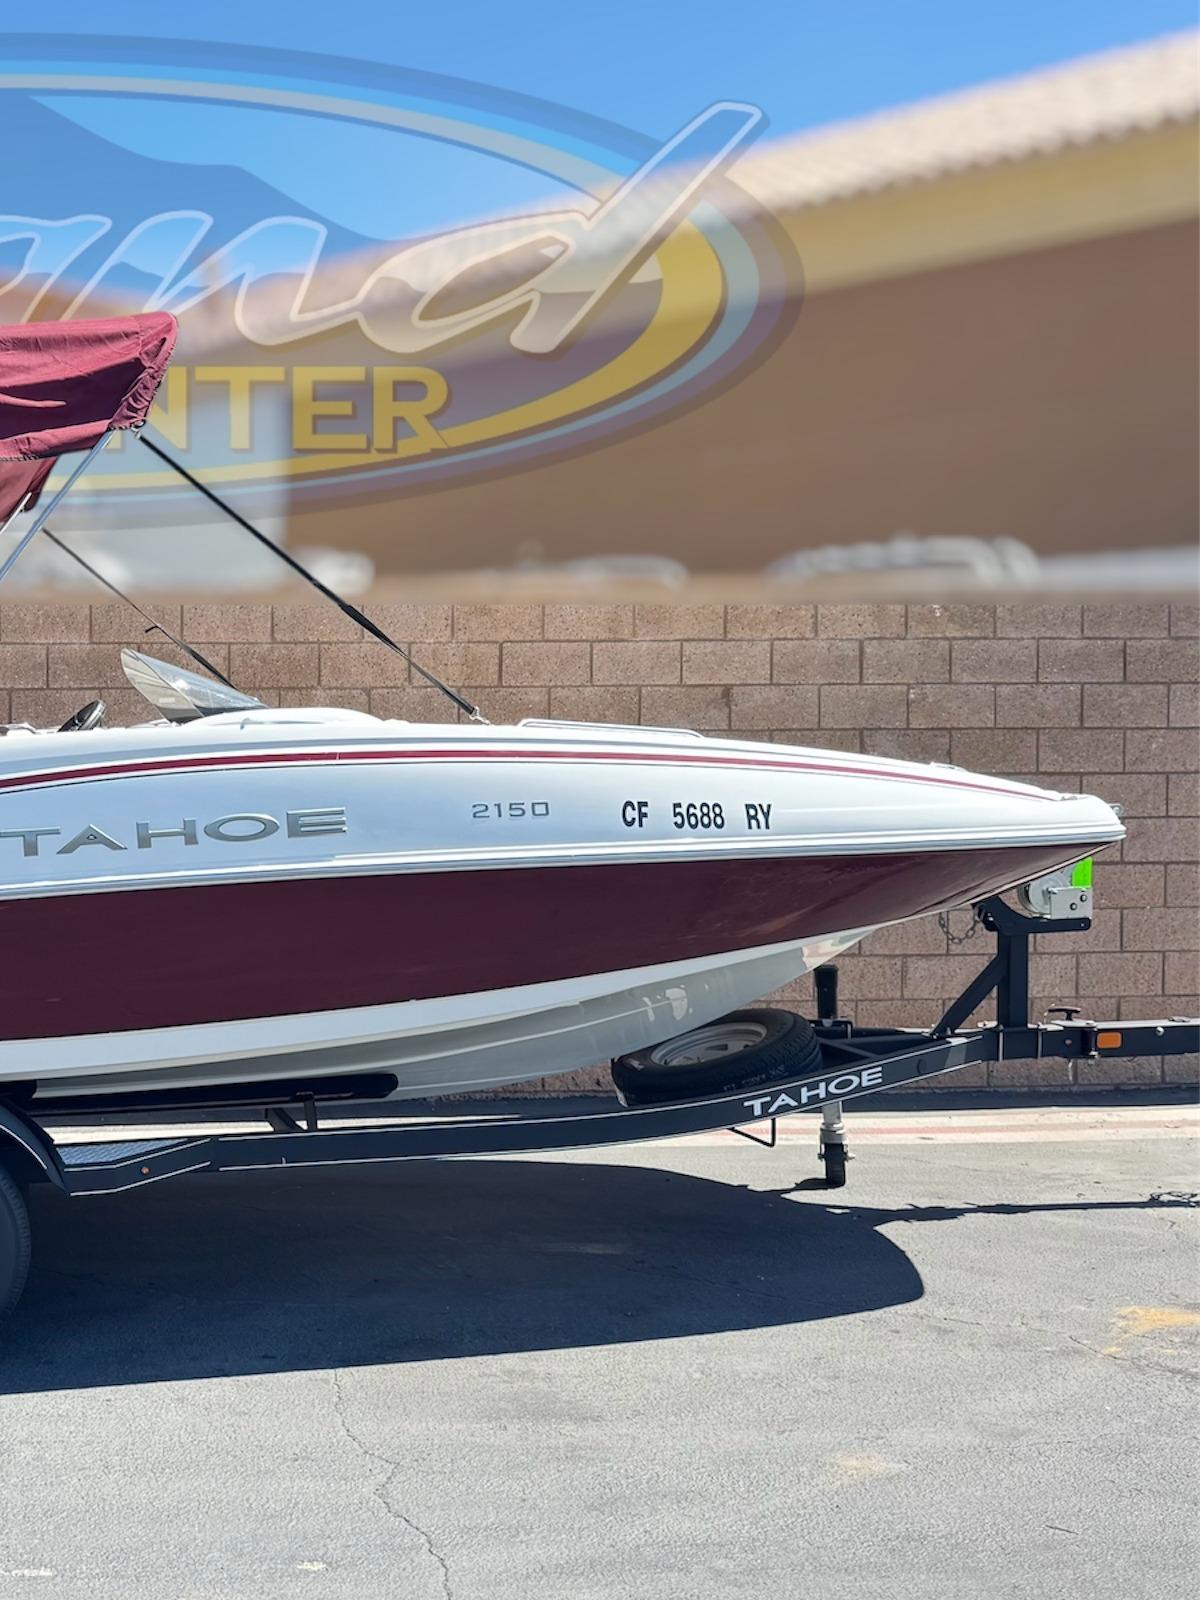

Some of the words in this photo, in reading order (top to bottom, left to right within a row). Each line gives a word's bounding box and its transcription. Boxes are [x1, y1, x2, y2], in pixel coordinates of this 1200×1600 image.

[471, 801, 551, 819] 2150
[621, 800, 649, 828] CF
[672, 802, 726, 830] 5688
[744, 803, 773, 830] RY
[743, 1066, 884, 1117] TAHOE
